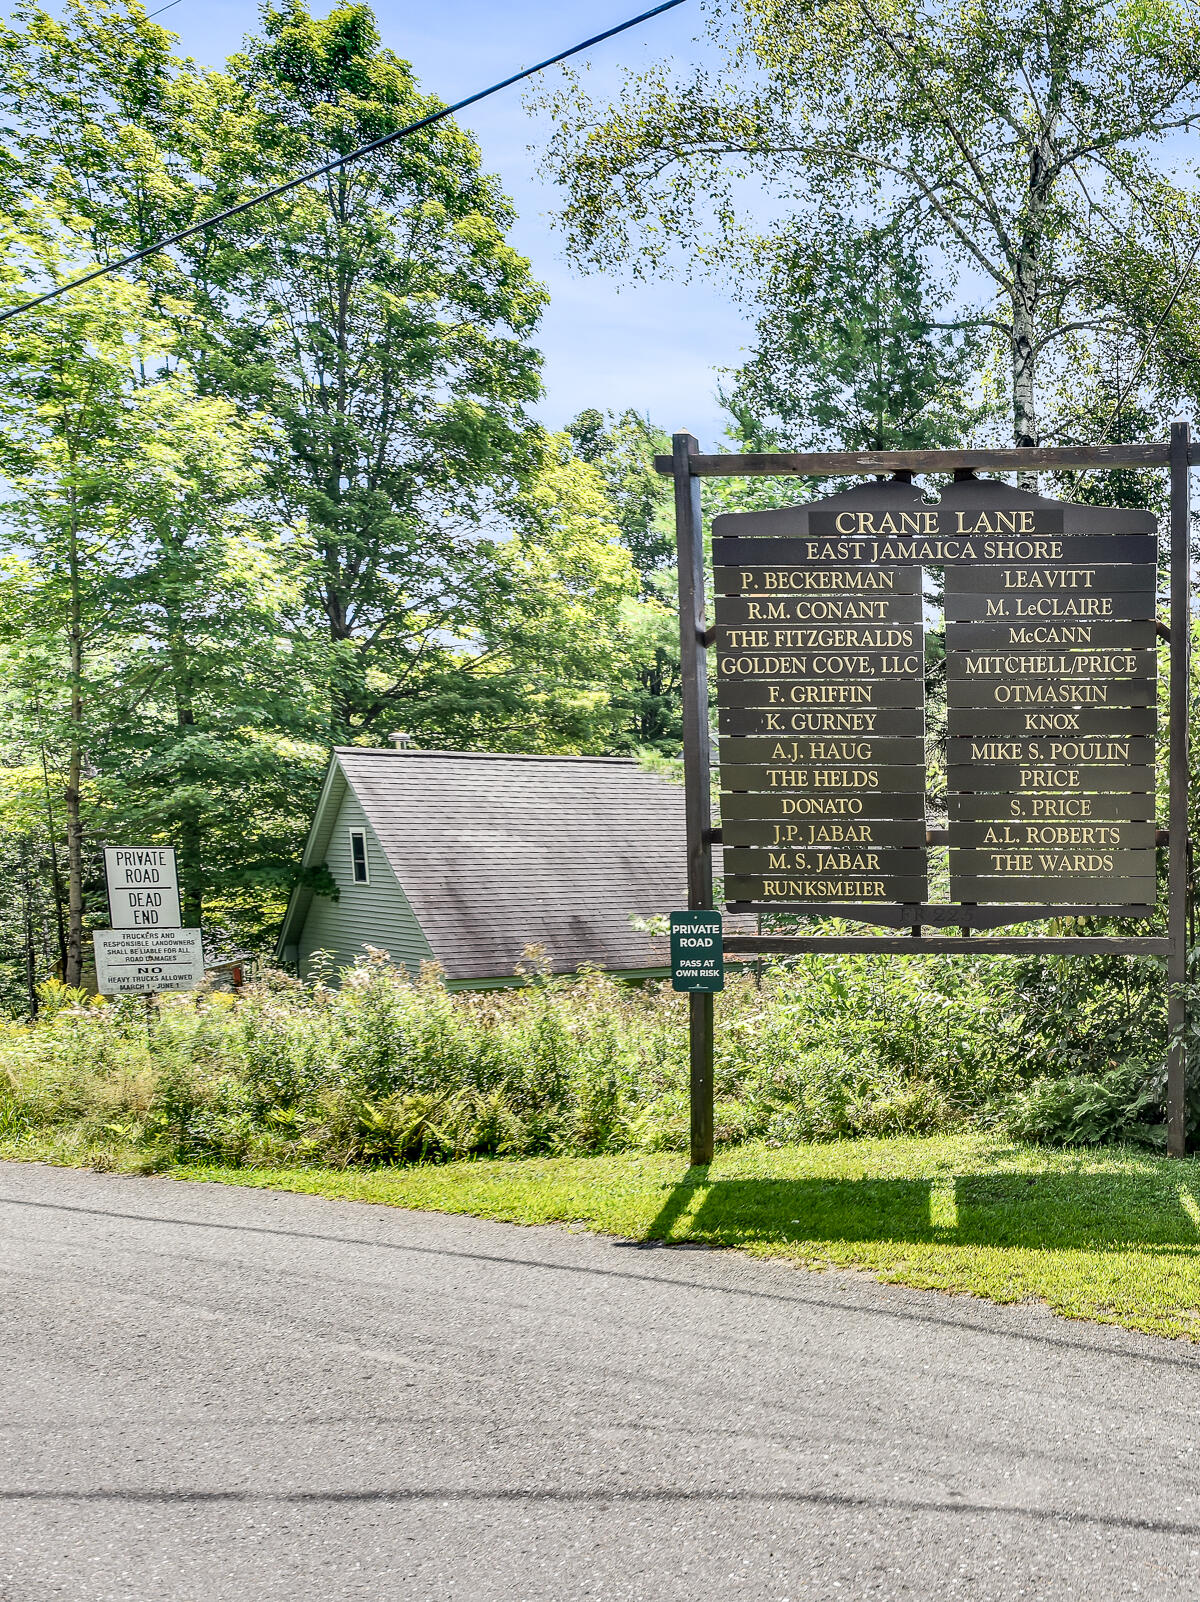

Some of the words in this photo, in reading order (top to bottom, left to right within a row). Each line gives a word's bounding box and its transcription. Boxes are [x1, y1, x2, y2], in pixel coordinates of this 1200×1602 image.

[835, 512, 939, 534] CRANE
[955, 511, 1035, 533] LANE
[805, 542, 865, 560] EAST
[870, 541, 977, 563] JAMAICA
[984, 541, 1063, 559] SHORE
[740, 572, 758, 589] P.
[764, 571, 893, 589] BECKERMAN
[1003, 570, 1095, 588] LEAVITT
[748, 602, 790, 619] R.M.
[796, 601, 889, 619] CONANT
[986, 599, 1010, 616] M.
[1016, 598, 1113, 616] LeCLAIRE
[726, 630, 769, 648] THE
[774, 630, 913, 647] FITZGERALDS
[1008, 627, 1092, 643] McCANN
[721, 657, 806, 675] GOLDEN
[812, 656, 875, 676] COVE,
[881, 656, 918, 673] LLC
[965, 656, 1137, 674] MITCHELL/PRICE
[768, 686, 785, 703] F.
[790, 686, 872, 703] GRIFFIN
[994, 685, 1108, 702] OTMASKIN
[766, 714, 786, 730] K.
[791, 713, 877, 731] GURNEY
[1024, 714, 1080, 730] KNOX
[771, 742, 803, 763] A.J.
[809, 742, 872, 760] HAUG
[971, 743, 1022, 760] MIKE
[1028, 743, 1044, 760] S.
[1050, 743, 1130, 760] POULIN
[766, 770, 809, 787] THE
[813, 770, 879, 787] HELDS
[1019, 770, 1080, 787] PRICE
[781, 798, 863, 814] DONATO
[1010, 799, 1026, 816] S.
[1032, 799, 1092, 816] PRICE
[773, 825, 803, 844] J.P.
[808, 825, 873, 845] JABAR
[984, 827, 1019, 843] A.L.
[1026, 827, 1120, 844] ROBERTS
[116, 851, 166, 866] PRIVATE
[768, 853, 791, 869] M.
[795, 853, 811, 869] S.
[816, 853, 880, 873] JABAR
[991, 855, 1033, 871] THE
[1038, 854, 1113, 871] WARDS
[125, 869, 160, 883] ROAD
[763, 881, 886, 896] RUNKSMEIER
[129, 893, 162, 907] DEAD
[134, 910, 159, 925] END
[672, 925, 720, 934] PRIVATE
[680, 938, 713, 947] ROAD
